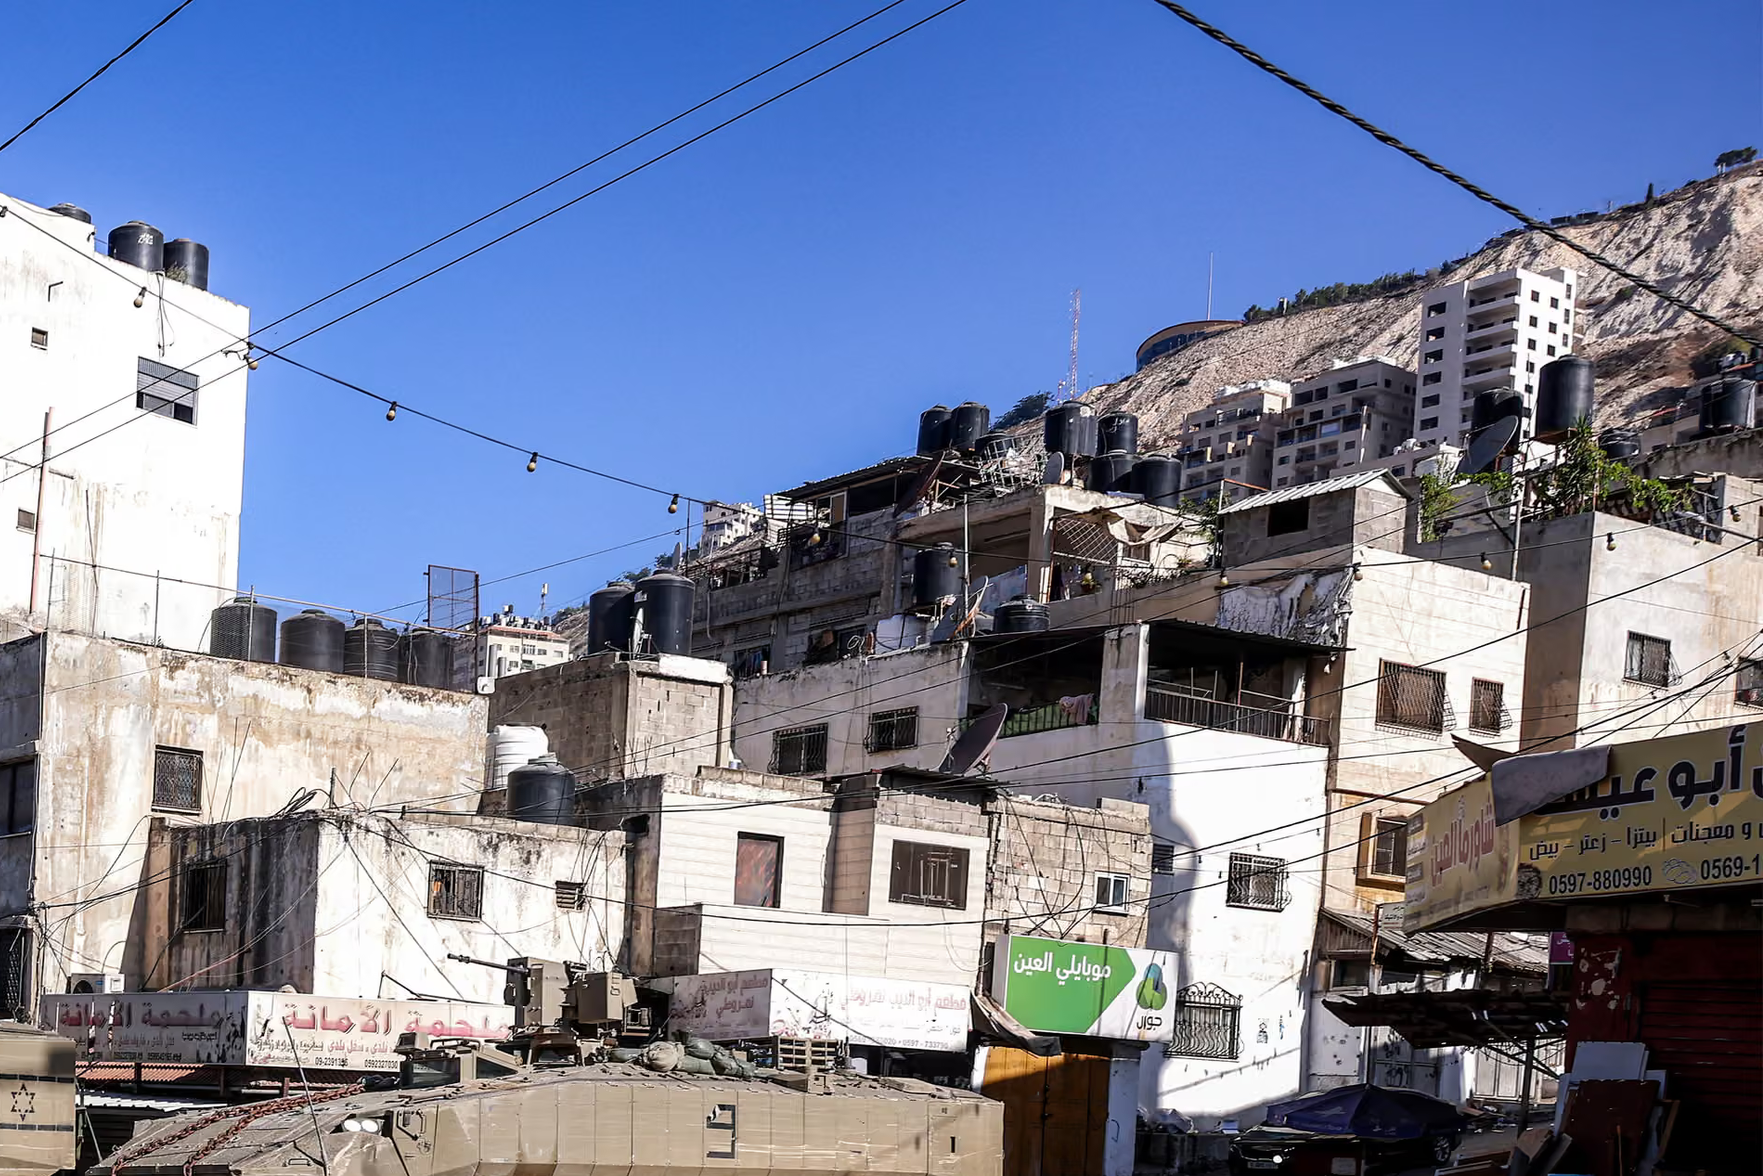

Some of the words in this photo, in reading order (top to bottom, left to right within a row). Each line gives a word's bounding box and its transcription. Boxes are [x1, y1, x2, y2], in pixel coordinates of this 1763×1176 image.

[1667, 724, 1747, 811] أبو
[1456, 791, 1495, 873] شاورما
[1578, 832, 1606, 855] زعتر
[1626, 826, 1657, 849] بيتزا
[1671, 821, 1735, 845] معجنات
[1529, 841, 1559, 861] بيض
[1549, 865, 1652, 895] 0597-880990
[1014, 951, 1054, 975] العين
[1056, 954, 1112, 985] موبايلي
[141, 1002, 224, 1030] ملحمة
[283, 1003, 392, 1036] الأمانة
[404, 1010, 514, 1040] ملحمة
[1136, 1015, 1163, 1032] جوال
